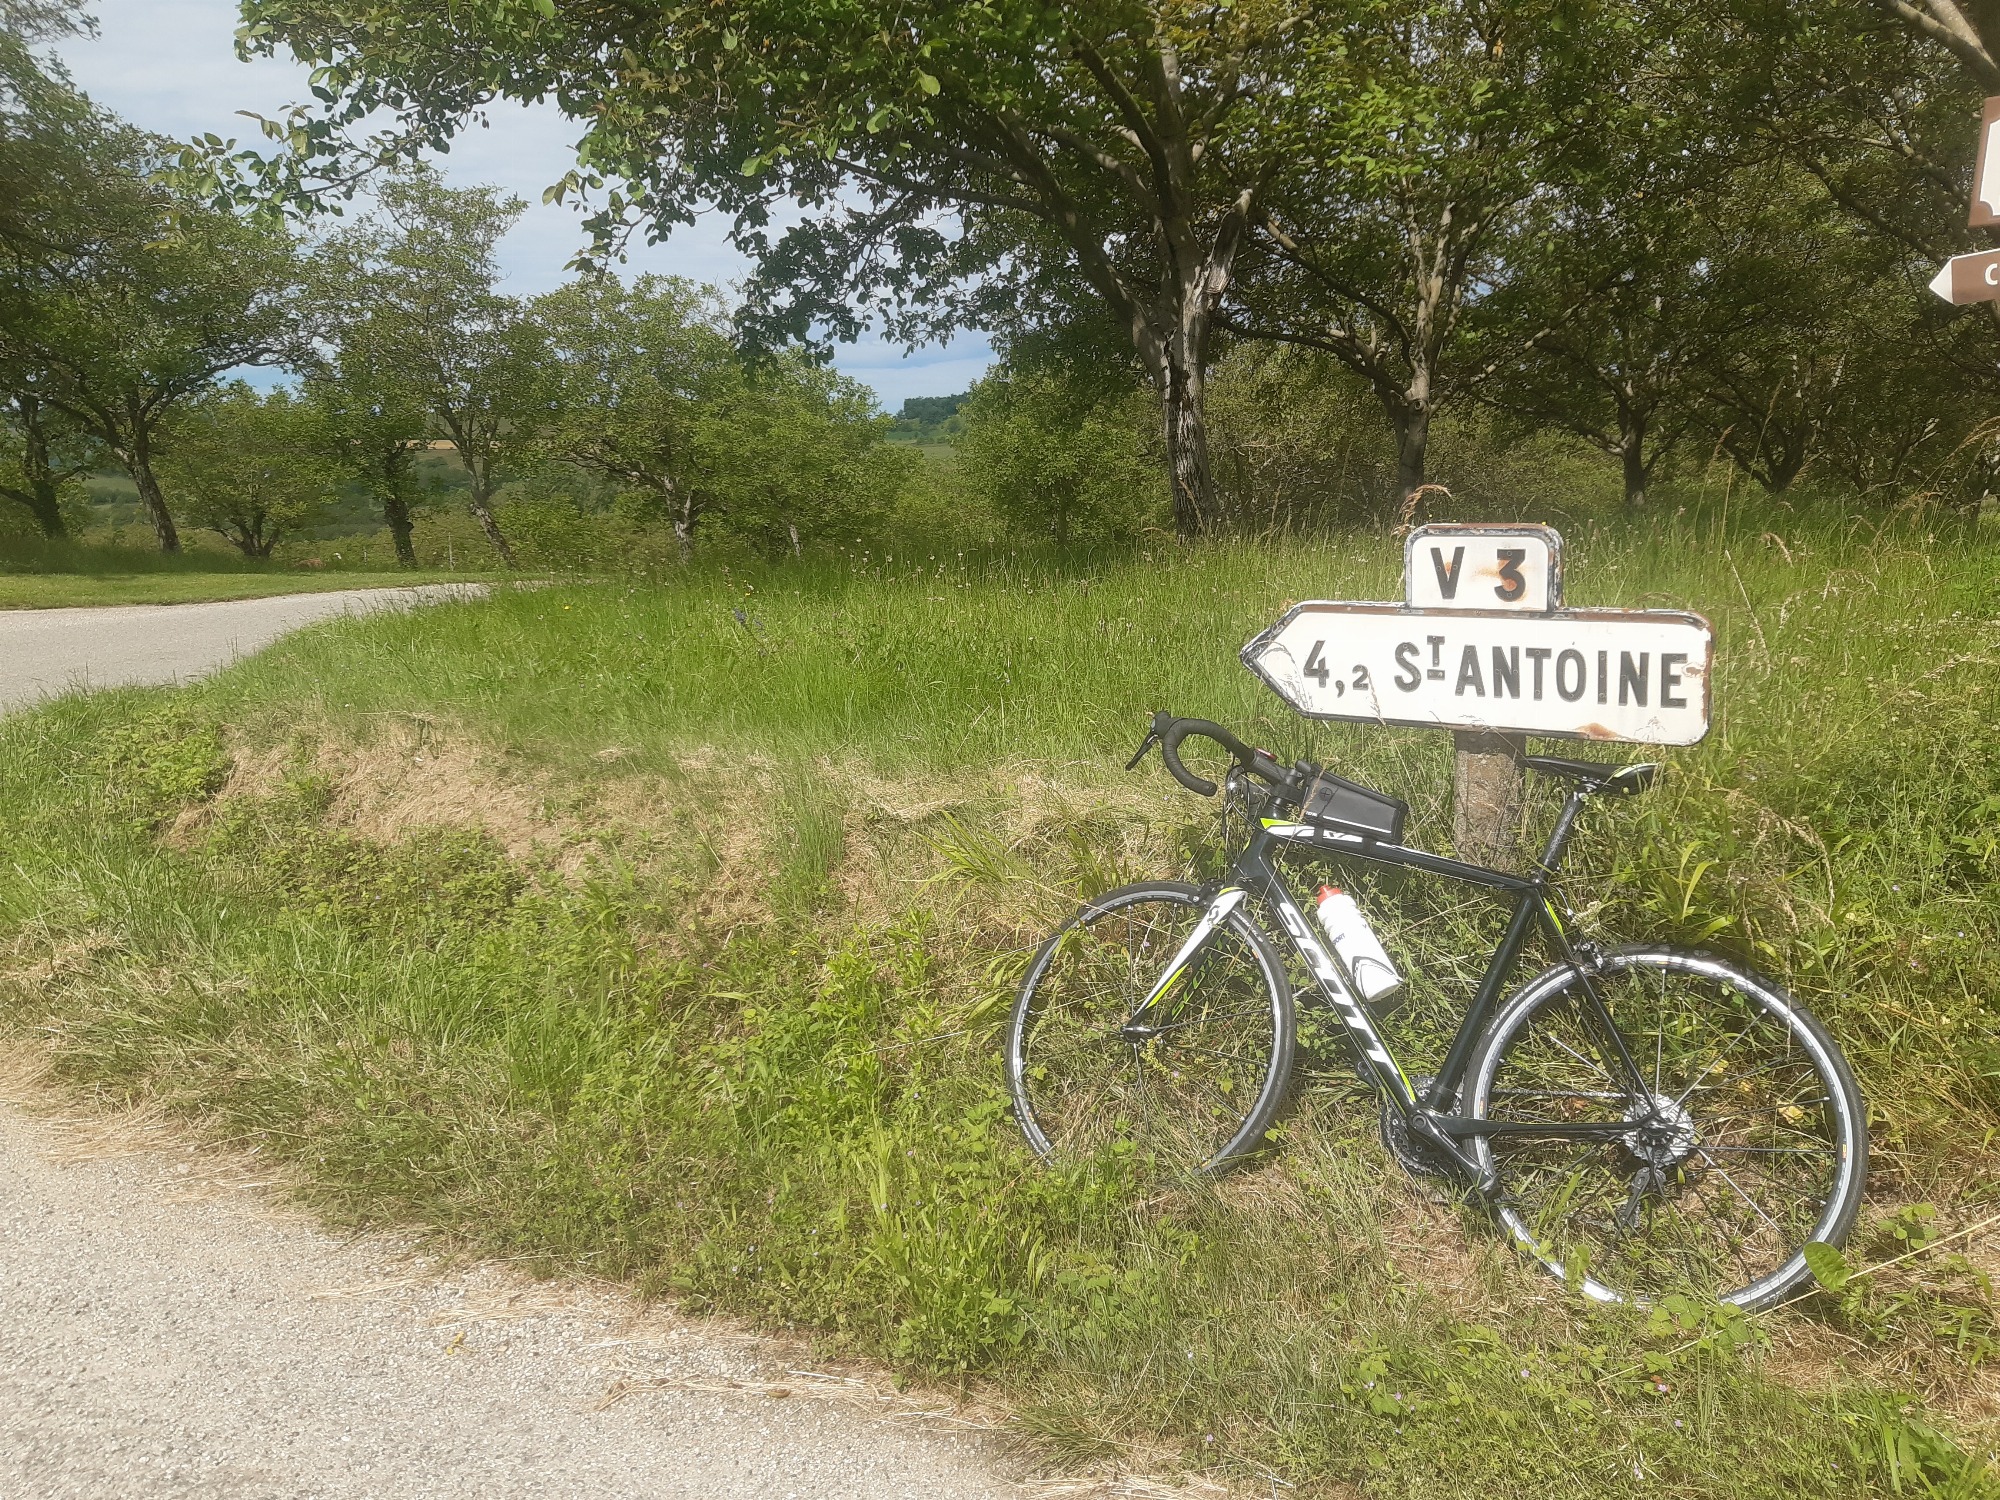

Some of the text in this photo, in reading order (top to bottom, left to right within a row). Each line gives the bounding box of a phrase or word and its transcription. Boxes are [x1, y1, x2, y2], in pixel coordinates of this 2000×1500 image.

[1984, 262, 1998, 286] C
[1430, 545, 1527, 602] V 3
[1302, 639, 1371, 698] 4,2
[1454, 644, 1689, 710] ANTOINE
[1277, 902, 1400, 1076] SCOTT
